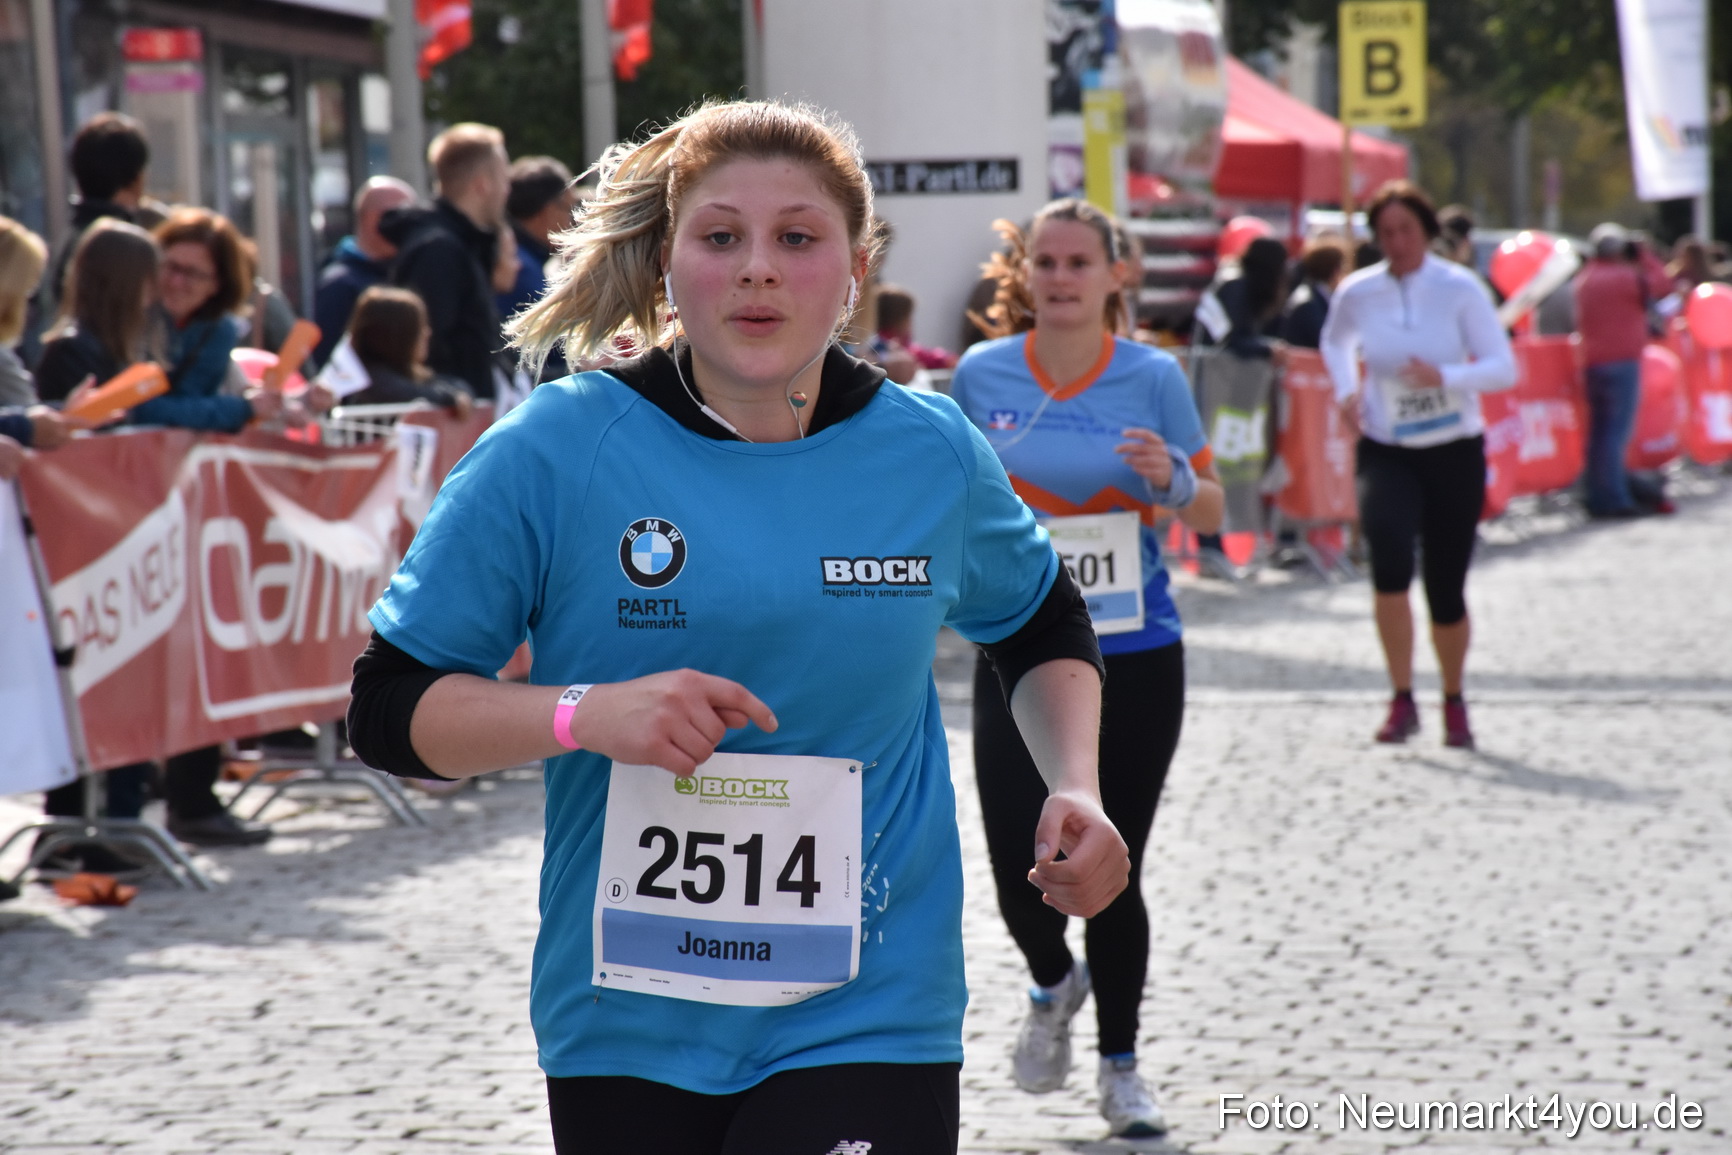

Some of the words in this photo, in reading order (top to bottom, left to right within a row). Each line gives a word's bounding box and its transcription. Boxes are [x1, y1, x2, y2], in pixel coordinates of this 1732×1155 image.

[1364, 40, 1402, 97] B
[626, 520, 681, 543] BMW
[820, 556, 932, 586] BOCK
[822, 587, 861, 598] inspired
[864, 588, 875, 599] by
[879, 588, 903, 597] smart
[905, 588, 933, 598] concepts
[618, 599, 687, 616] PARTL
[618, 616, 687, 629] Neumarkt
[700, 777, 789, 800] BOCK
[699, 797, 727, 806] inspired
[729, 799, 737, 807] by
[636, 826, 821, 908] 2514
[612, 884, 621, 898] D
[677, 931, 771, 962] Joanna
